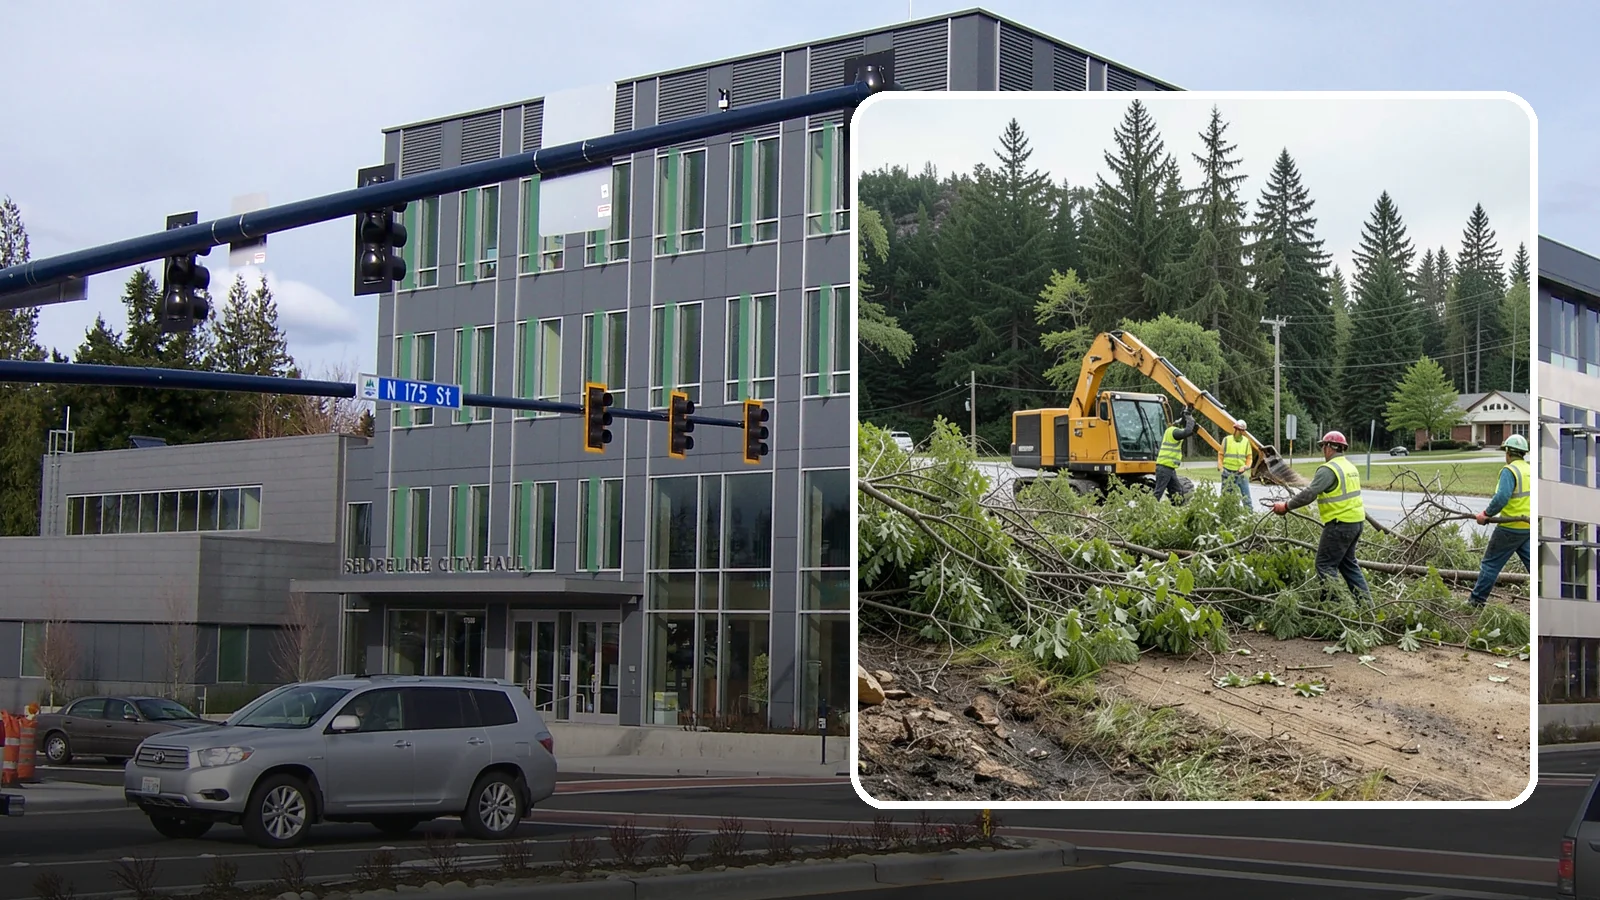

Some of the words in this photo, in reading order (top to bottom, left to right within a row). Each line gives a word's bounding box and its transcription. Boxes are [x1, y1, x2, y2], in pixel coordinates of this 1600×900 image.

[387, 380, 396, 400] N
[405, 382, 427, 403] 175
[436, 386, 452, 406] St
[344, 557, 432, 574] SHORELINE
[438, 556, 475, 572] CITY
[483, 556, 525, 571] HALL
